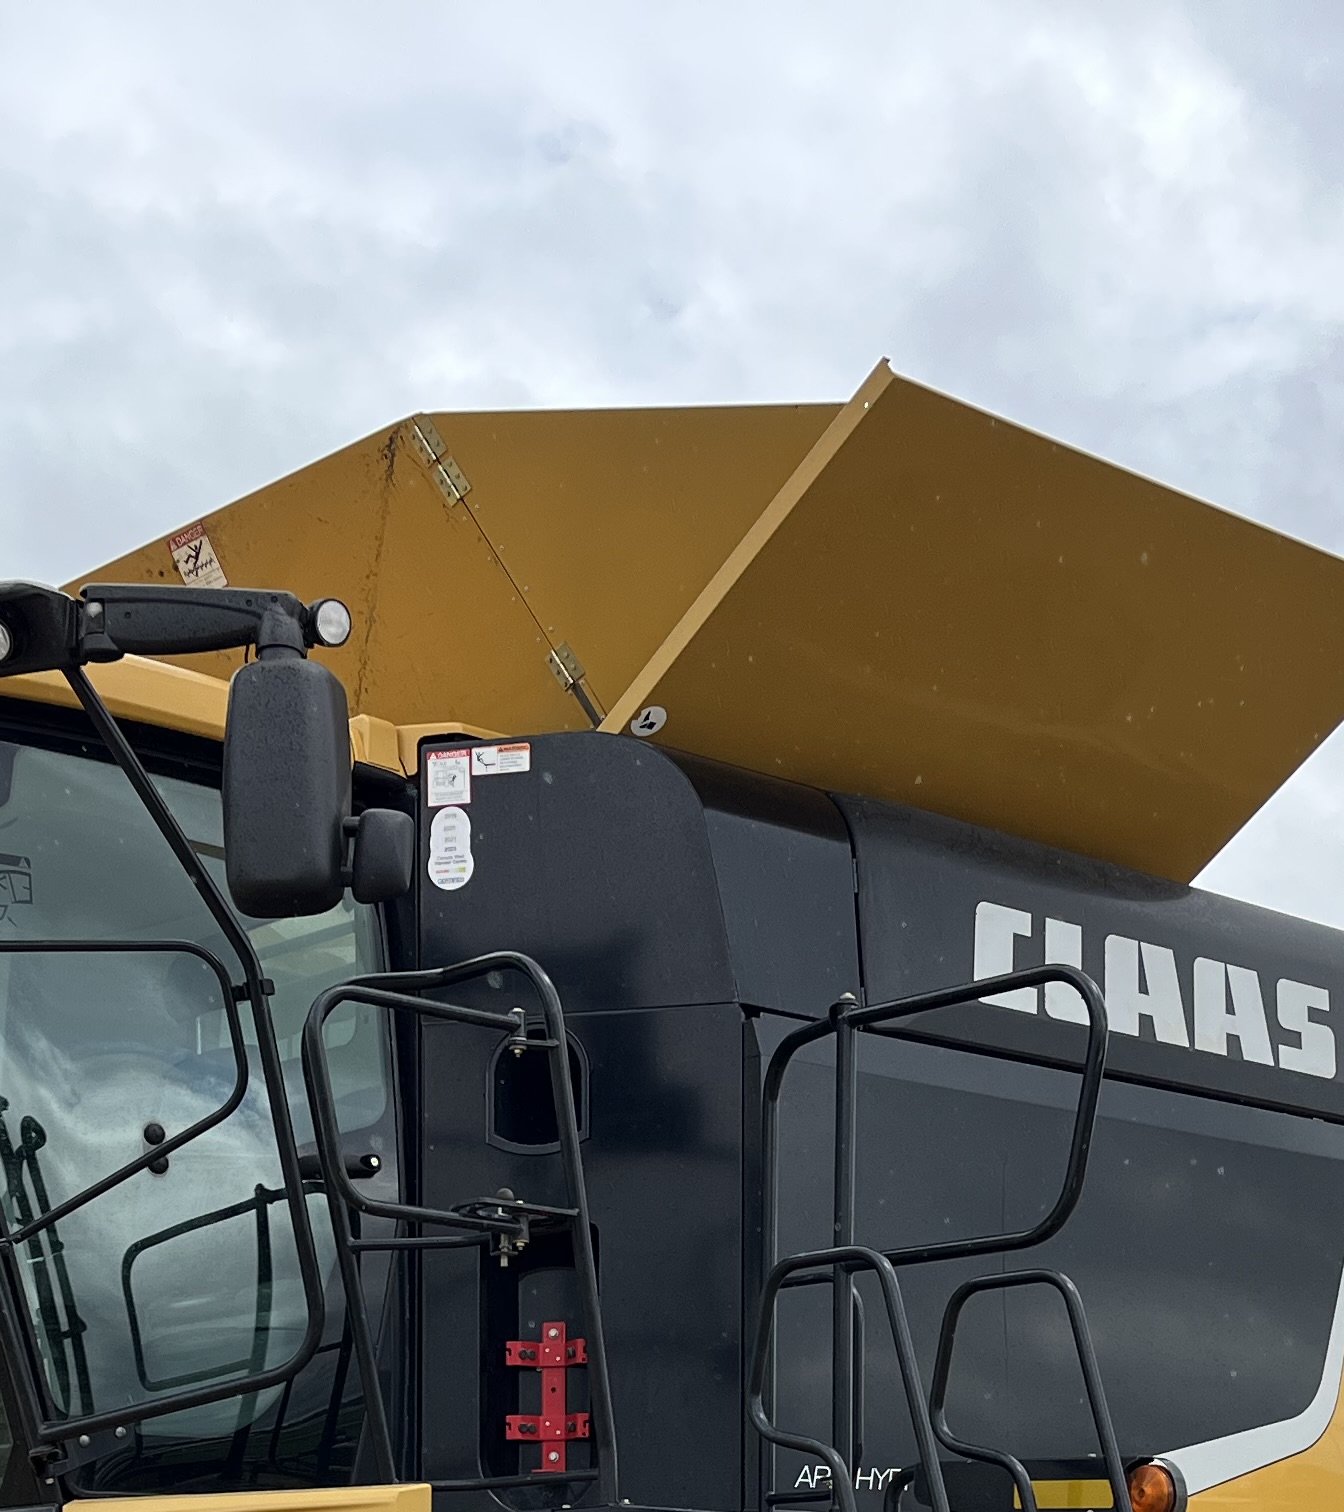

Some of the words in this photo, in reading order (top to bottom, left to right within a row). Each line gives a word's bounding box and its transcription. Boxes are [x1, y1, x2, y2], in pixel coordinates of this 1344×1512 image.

[175, 524, 204, 547] DANGER
[437, 749, 467, 758] DANGER
[974, 901, 1337, 1079] CLAAS
[794, 1464, 833, 1489] AP
